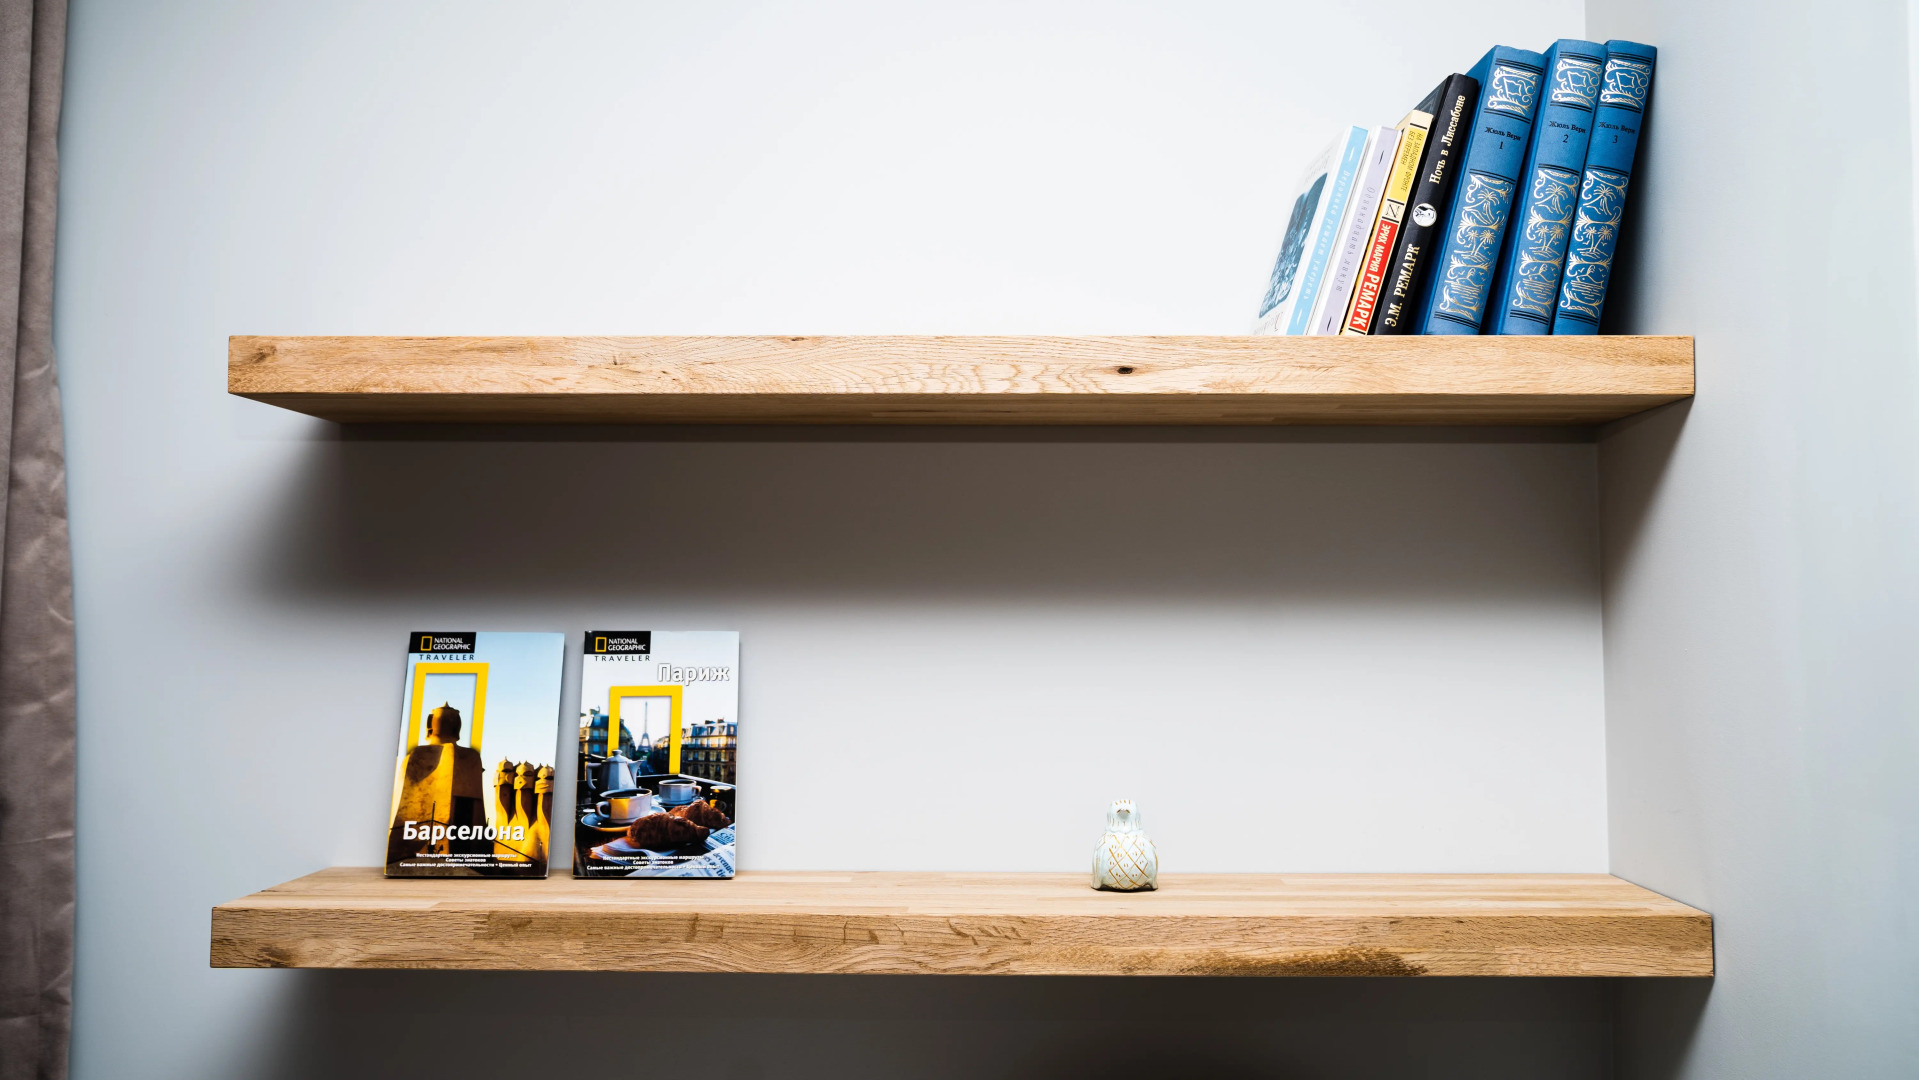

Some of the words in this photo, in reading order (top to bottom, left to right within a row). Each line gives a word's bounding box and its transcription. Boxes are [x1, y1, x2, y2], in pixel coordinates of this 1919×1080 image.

[1484, 126, 1506, 137] Жюль
[1506, 131, 1522, 141] Верн
[1549, 120, 1570, 130] Жюль
[1571, 124, 1586, 134] Верн
[1598, 121, 1619, 131] Жюль
[1621, 125, 1636, 135] Верн
[1429, 159, 1446, 184] Ночь
[1441, 94, 1466, 147] Лиссабоне
[1499, 141, 1504, 150] 1
[1562, 134, 1569, 143] 2
[1612, 134, 1619, 144] 3
[1378, 223, 1391, 245] ЭРИХ
[1369, 244, 1385, 272] МАРИЯ
[1394, 243, 1420, 298] РЕМАРК
[1352, 273, 1380, 328] РЕМАРК
[657, 663, 730, 686] Париж
[403, 820, 525, 845] Барселона
